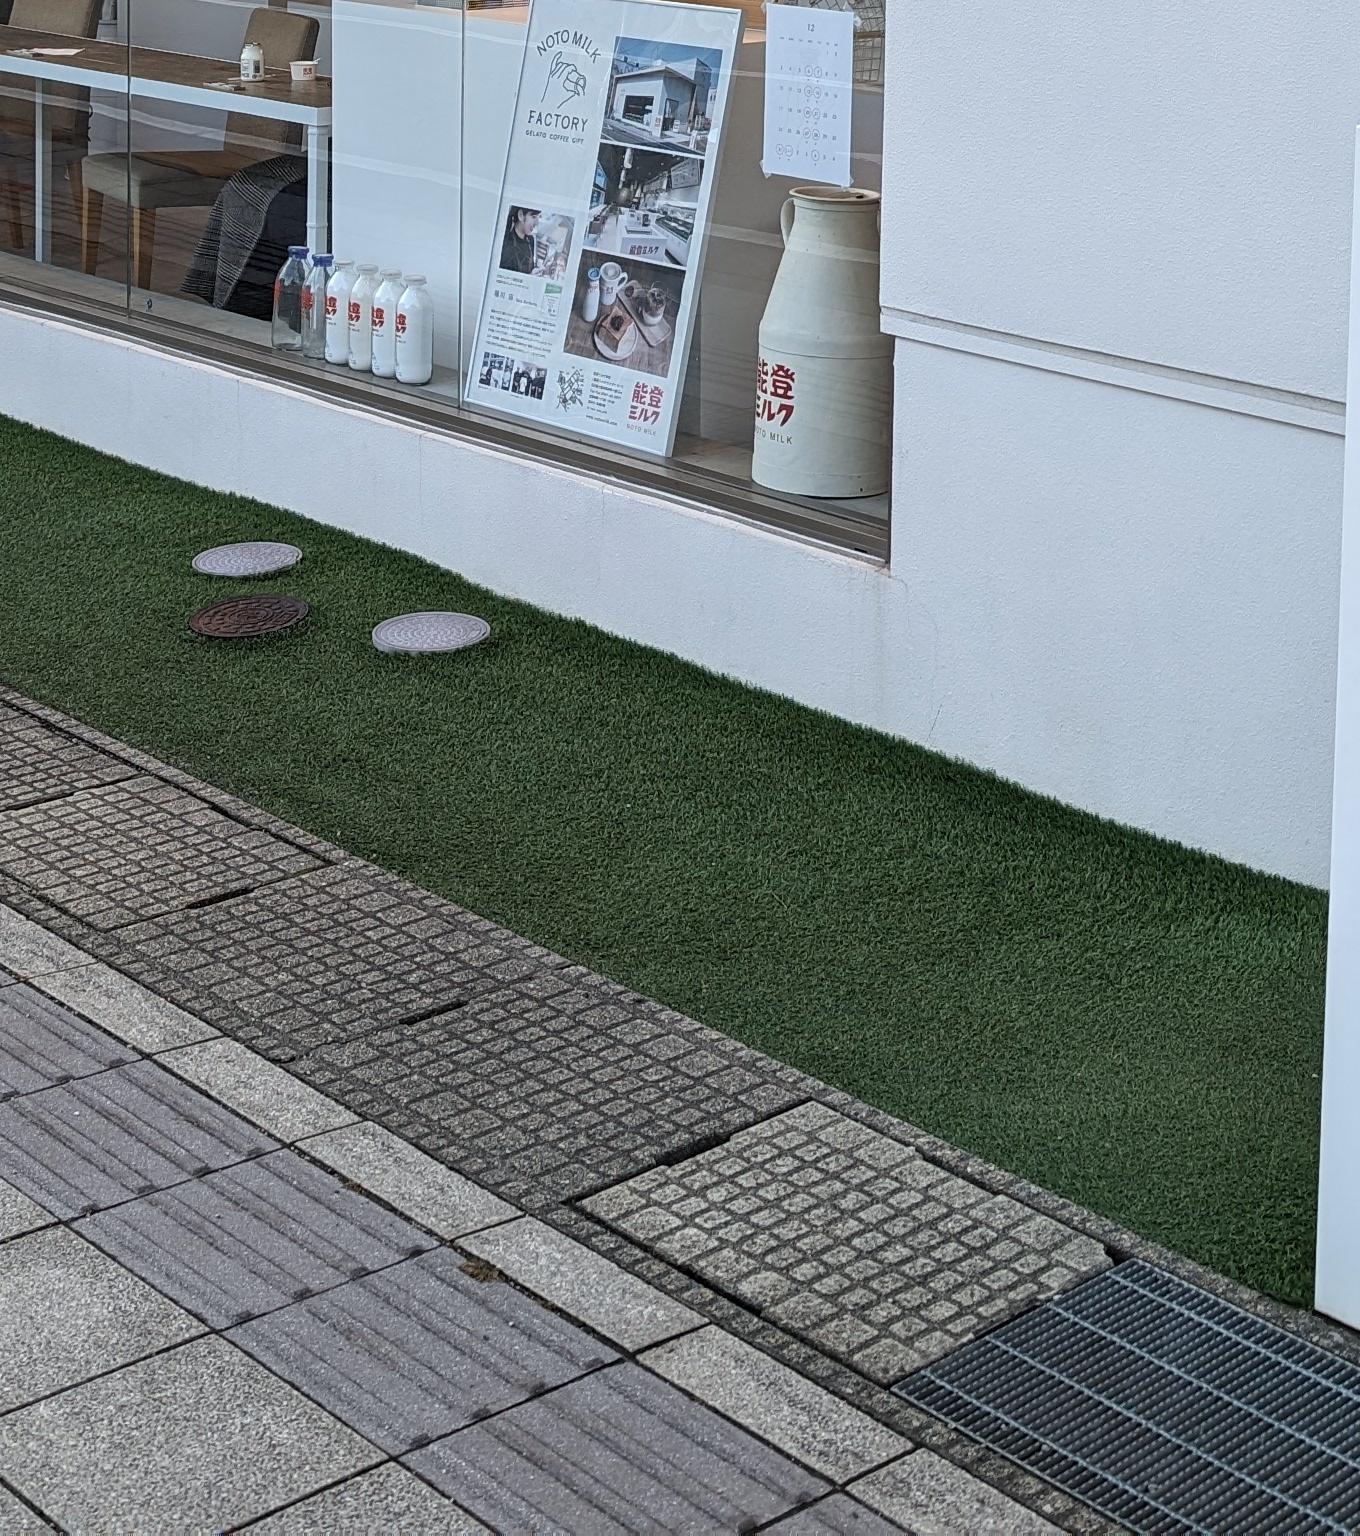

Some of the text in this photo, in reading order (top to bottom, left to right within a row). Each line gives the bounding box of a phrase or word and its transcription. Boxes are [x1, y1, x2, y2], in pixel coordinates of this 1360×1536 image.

[536, 29, 602, 64] NOTO MILK
[527, 109, 589, 133] FACTORY
[525, 128, 547, 139] GELATO
[549, 133, 570, 143] COFFEE
[631, 381, 664, 409] 能登
[628, 405, 660, 426] ミルク
[755, 425, 793, 445] OTO MILK
